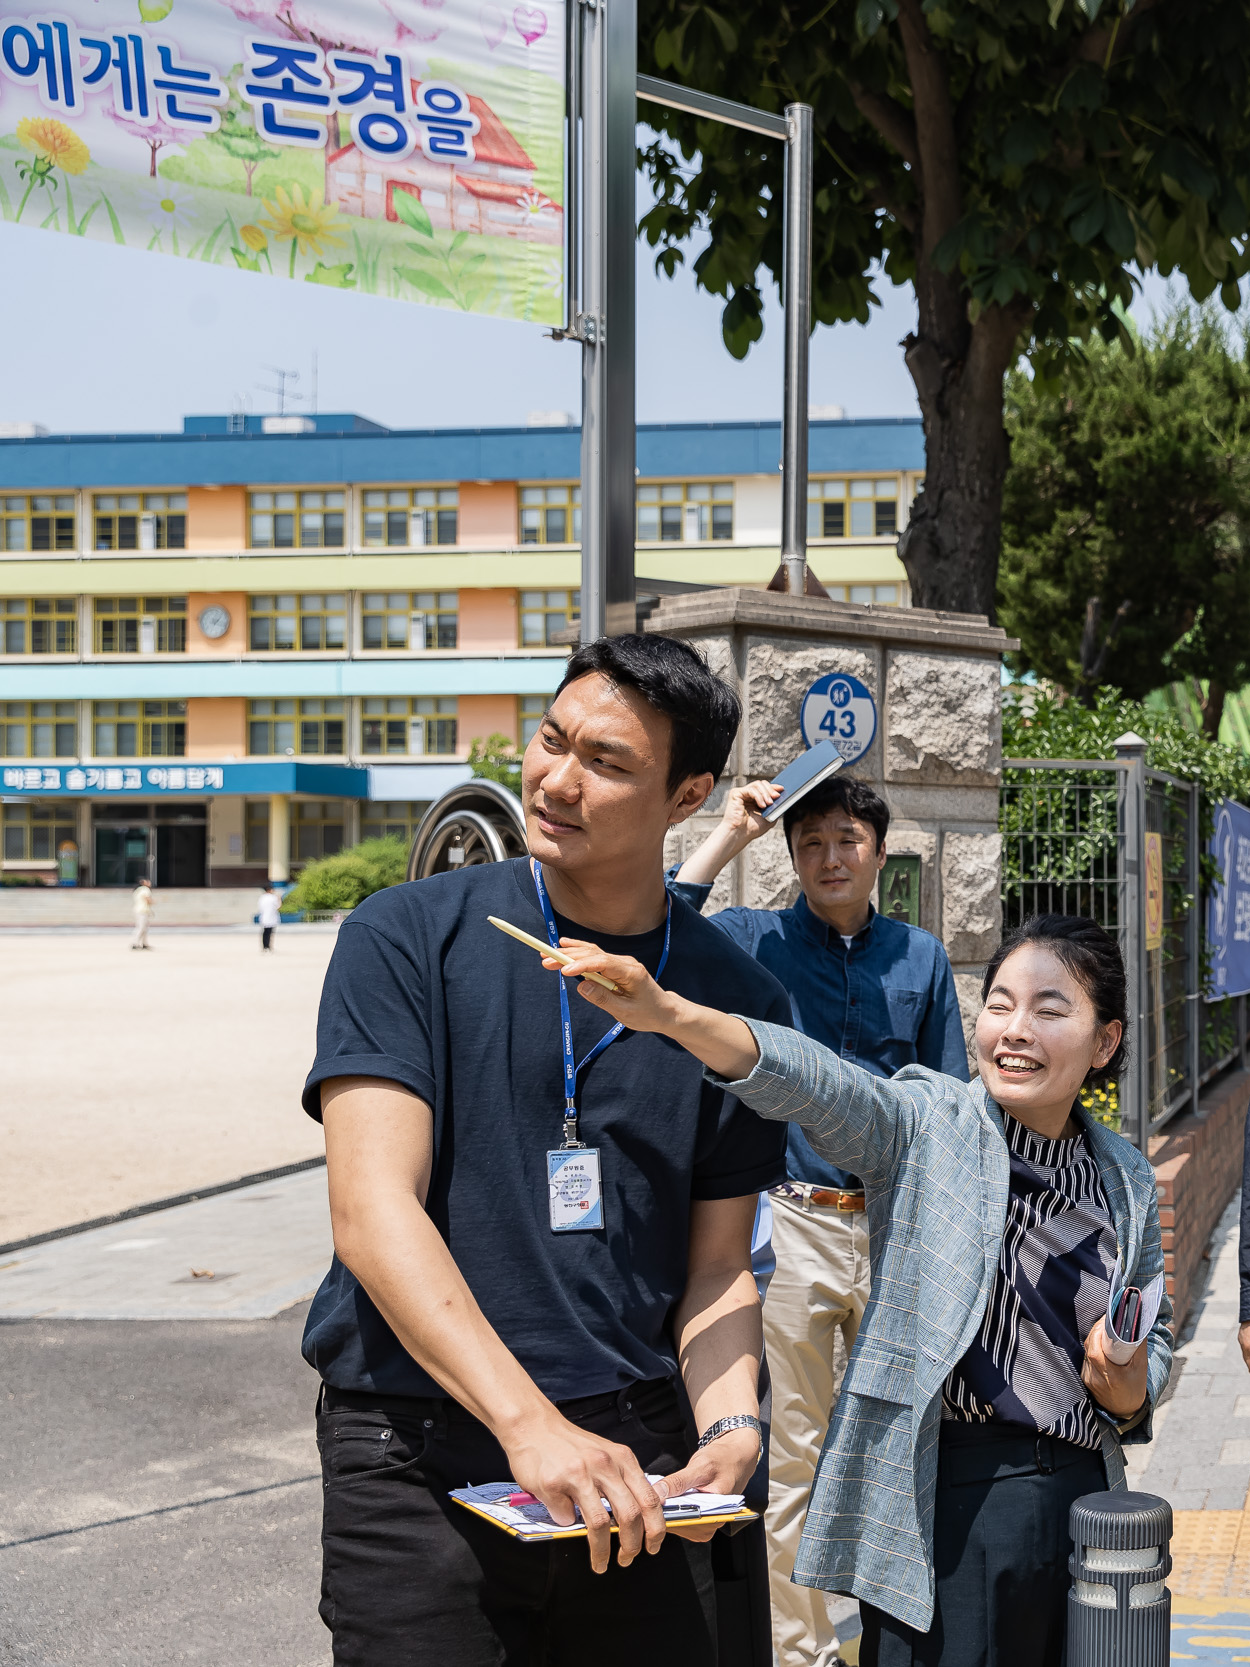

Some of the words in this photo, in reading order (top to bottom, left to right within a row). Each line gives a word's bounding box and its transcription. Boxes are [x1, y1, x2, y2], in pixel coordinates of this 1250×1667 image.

[2, 20, 221, 125] 에게는
[245, 41, 474, 159] 존경을
[818, 709, 856, 739] 43
[4, 768, 61, 790] 바르고
